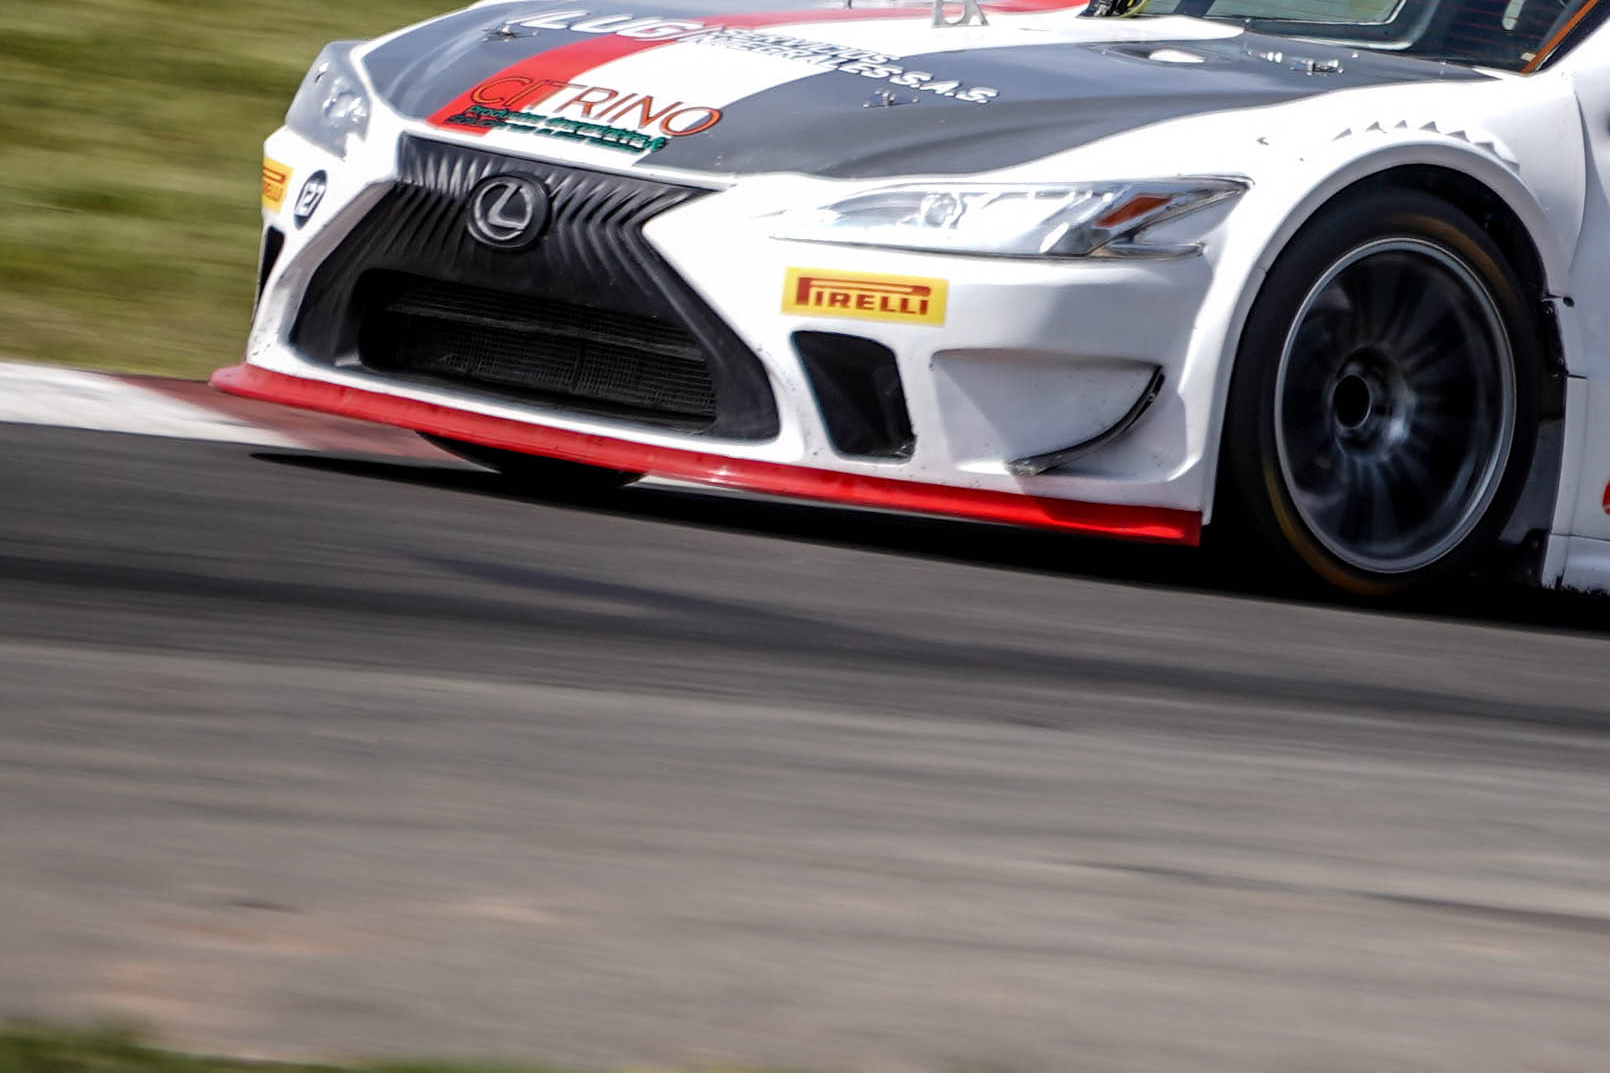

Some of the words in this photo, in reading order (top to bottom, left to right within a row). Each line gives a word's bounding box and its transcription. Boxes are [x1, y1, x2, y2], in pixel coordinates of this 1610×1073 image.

[471, 75, 724, 138] CITRINO
[889, 70, 1000, 105] S.A.S.
[795, 276, 932, 316] PIRELLI
